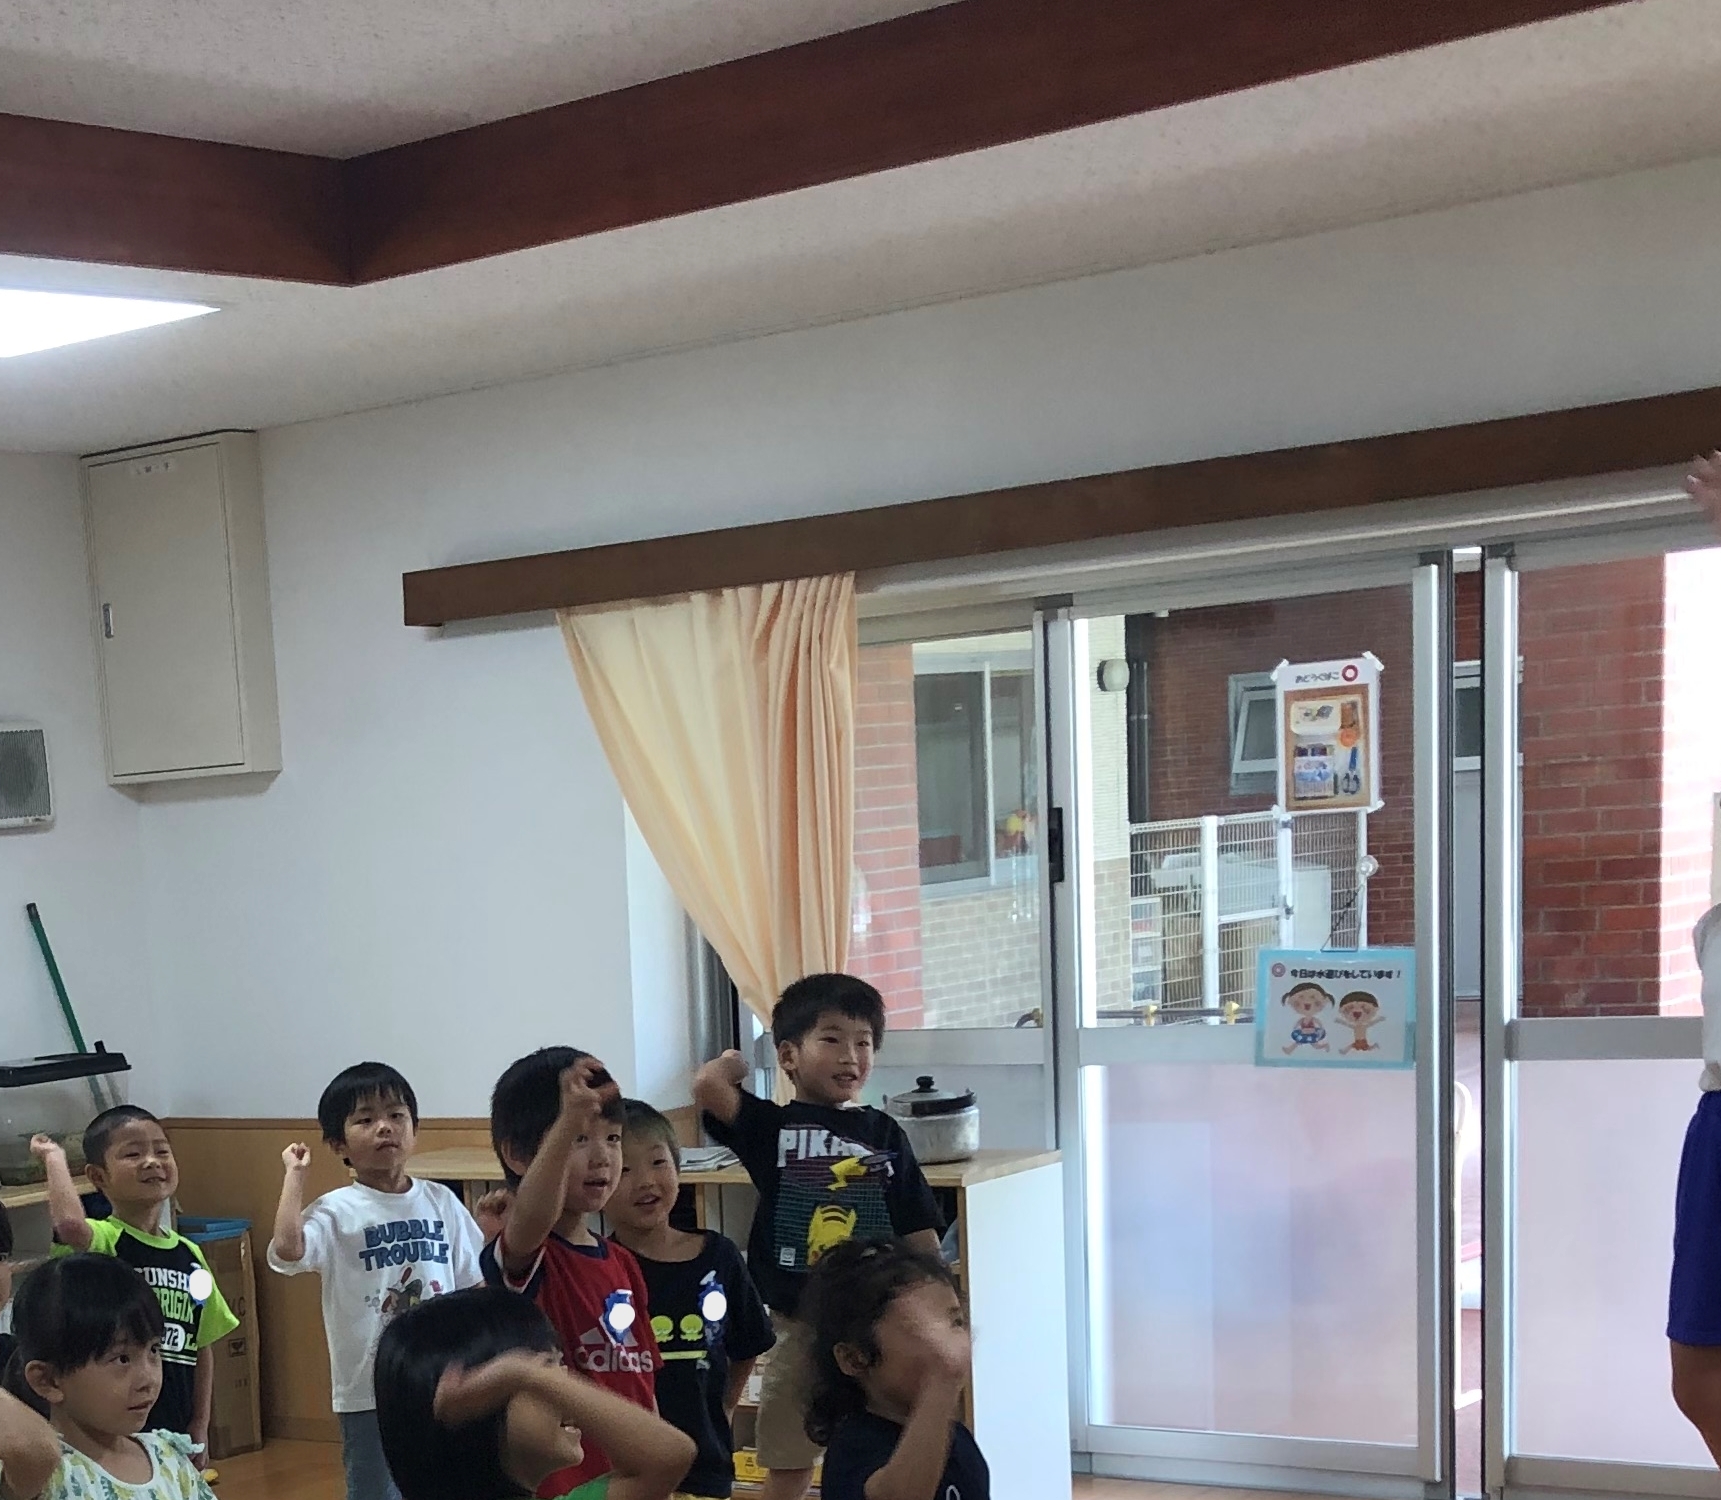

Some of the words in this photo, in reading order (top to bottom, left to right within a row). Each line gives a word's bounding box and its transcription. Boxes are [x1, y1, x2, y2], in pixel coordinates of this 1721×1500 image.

[777, 1128, 872, 1167] PIKA
[364, 1219, 444, 1248] BUBBLE
[359, 1241, 450, 1271] TROUBLE
[134, 1267, 190, 1291] UNSH
